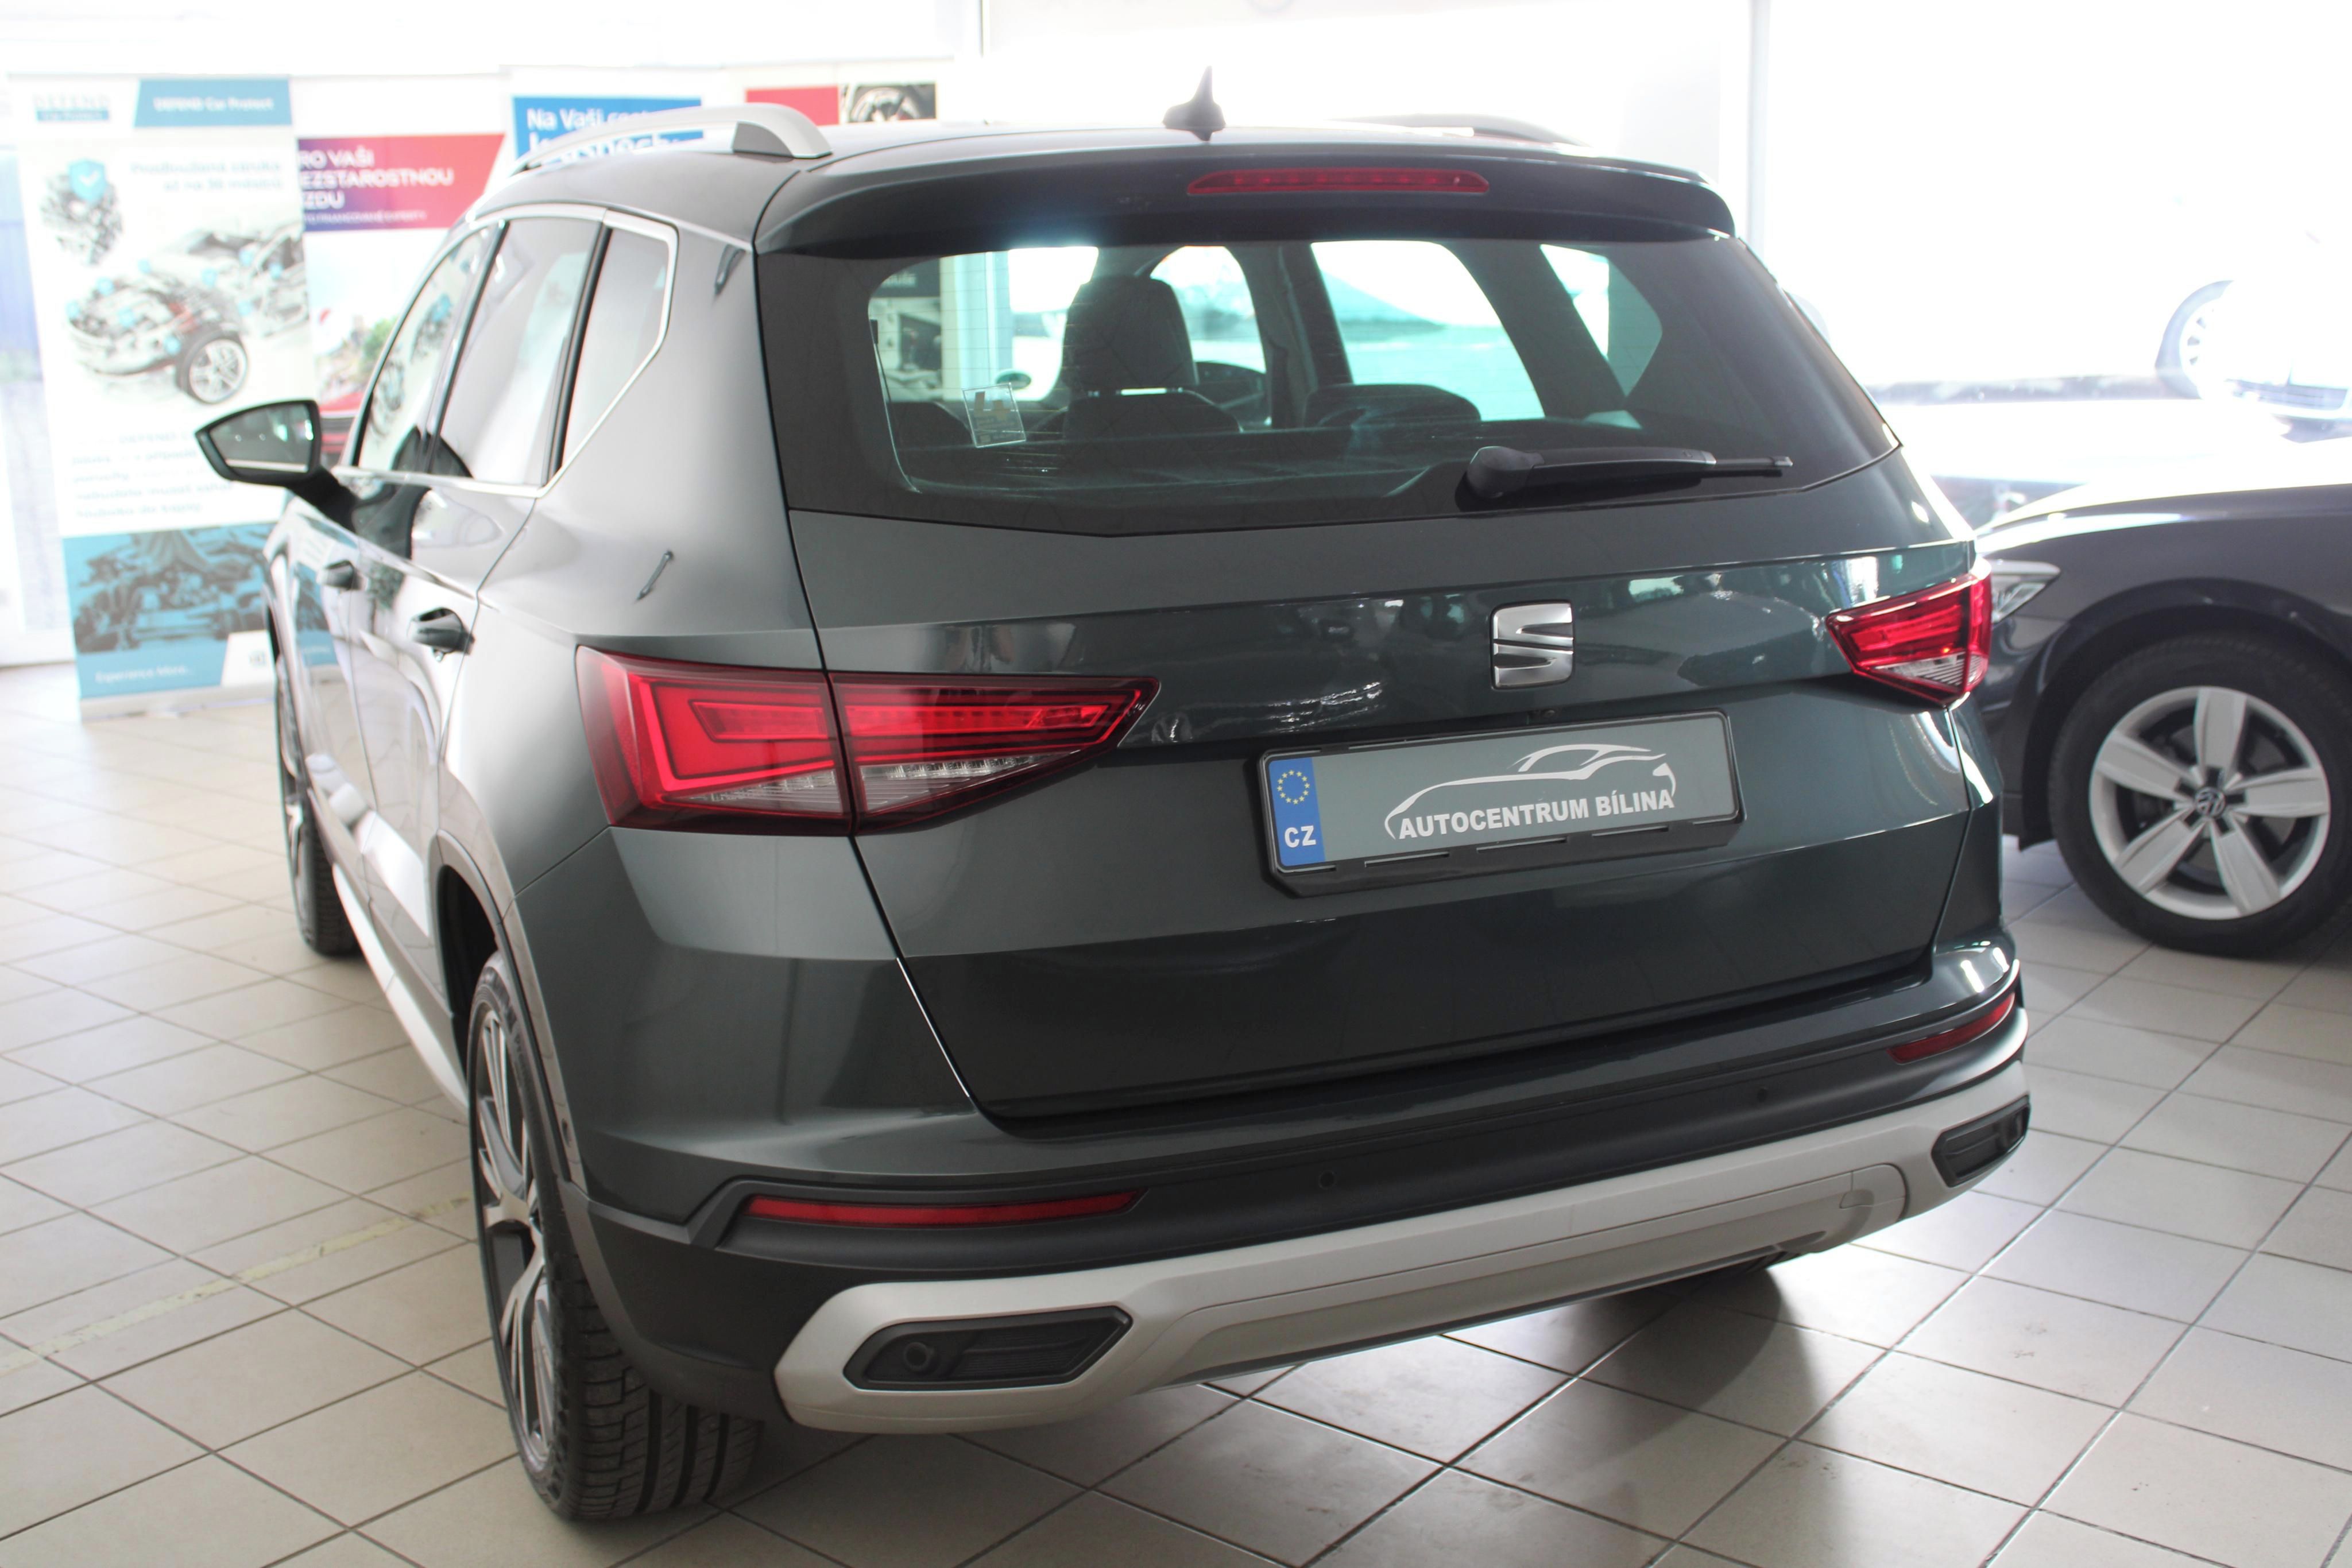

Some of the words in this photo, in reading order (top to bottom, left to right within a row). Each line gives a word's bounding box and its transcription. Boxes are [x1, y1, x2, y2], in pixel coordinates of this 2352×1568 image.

[527, 107, 552, 129] Na
[297, 149, 327, 169] RO
[326, 145, 374, 168] VAŠI
[300, 167, 454, 189] EZSTAROSTNOU
[302, 190, 345, 210] ZDU
[1399, 797, 1589, 839] AUTOCENTRUM
[1595, 789, 1675, 817] BÍLINA
[1285, 825, 1316, 848] CZ
